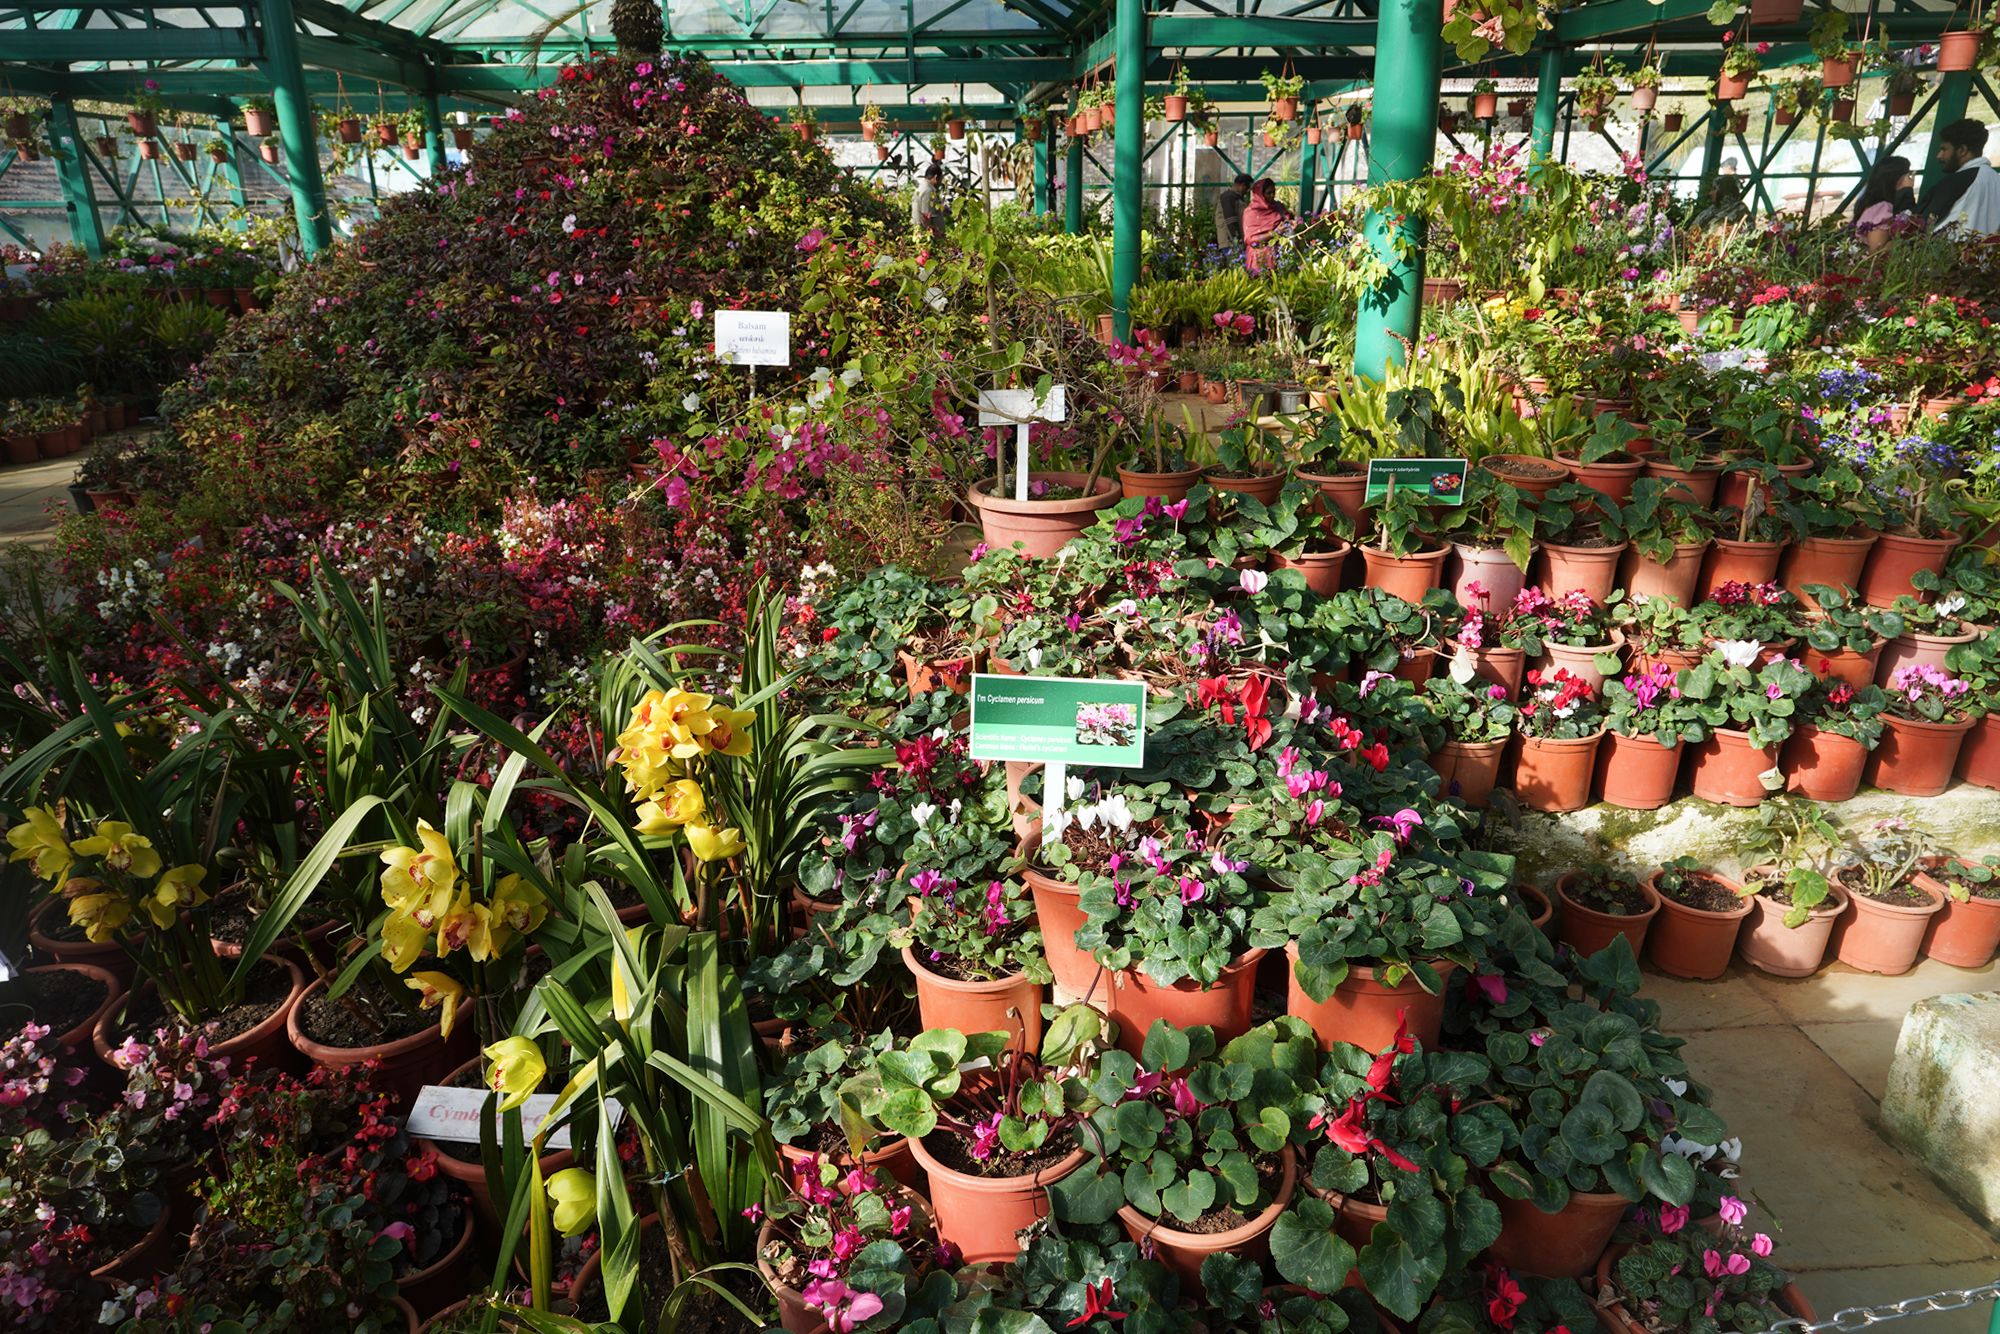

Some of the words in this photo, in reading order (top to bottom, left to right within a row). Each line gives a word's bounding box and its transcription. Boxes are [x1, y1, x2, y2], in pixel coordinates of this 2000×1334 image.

[738, 321, 767, 330] Balsam
[977, 694, 986, 702] I'm
[987, 694, 1016, 705] Cyclamen
[1016, 696, 1045, 706] persicum
[999, 743, 1016, 751] Name
